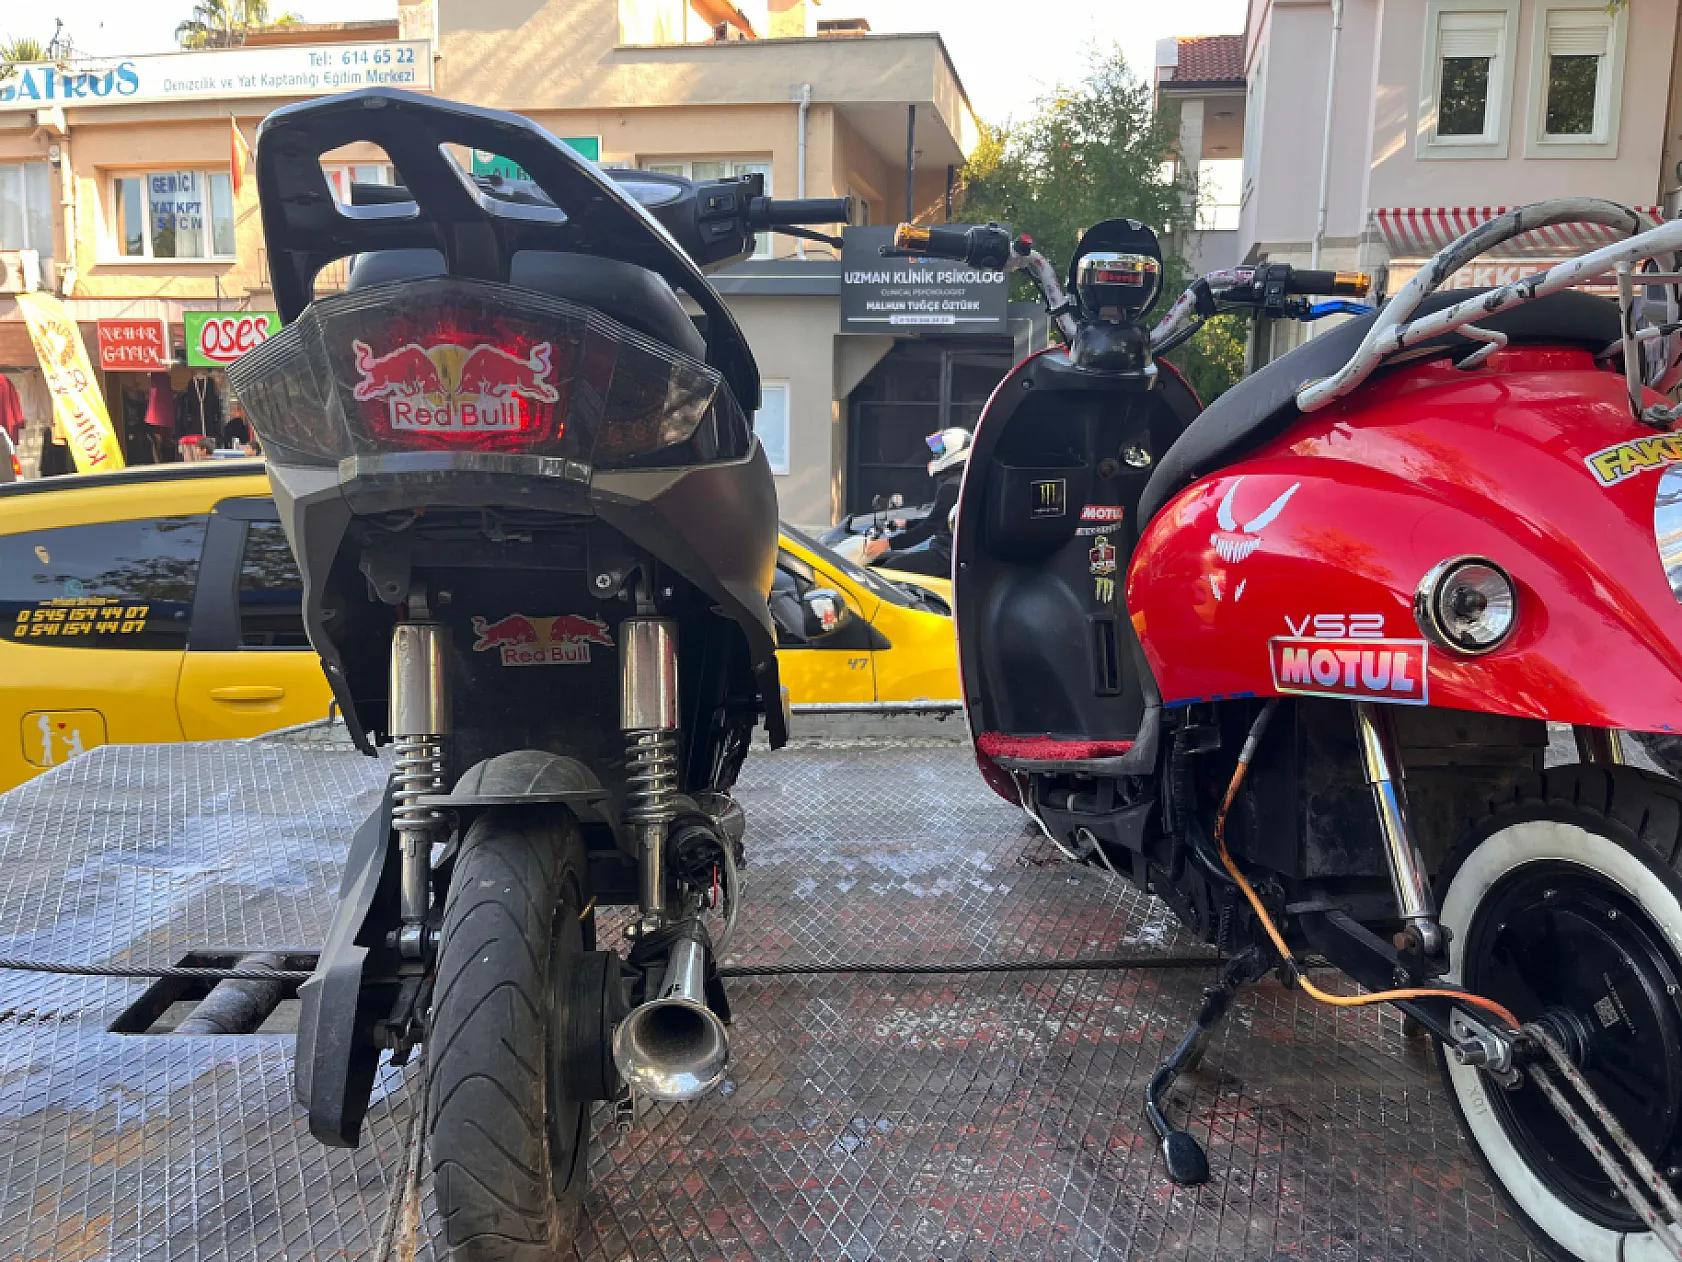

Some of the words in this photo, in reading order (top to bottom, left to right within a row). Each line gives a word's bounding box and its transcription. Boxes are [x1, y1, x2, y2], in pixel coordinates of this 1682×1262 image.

[342, 50, 369, 65] 614
[373, 49, 391, 64] 65
[396, 48, 415, 63] 22
[220, 78, 233, 88] ve
[238, 74, 257, 87] Yat
[323, 70, 362, 87] Eğitim
[366, 68, 415, 84] Merkezi
[844, 271, 890, 284] UZMAN
[893, 268, 934, 284] KLİNİK
[936, 268, 1005, 284] PSİKOLOG
[941, 299, 980, 311] ÖZTÜRK
[394, 401, 451, 426] Red
[461, 402, 515, 426] Bull
[16, 610, 31, 622] 0
[32, 608, 68, 622] 545
[101, 606, 124, 619] 44
[124, 605, 150, 619] 07
[14, 623, 29, 637] 0
[62, 621, 93, 636] 154
[95, 621, 119, 634] 44
[120, 620, 146, 633] 07
[1283, 613, 1385, 638] VS2
[503, 648, 546, 663] Red
[551, 645, 588, 661] Bull
[847, 657, 869, 670] 47
[1281, 646, 1414, 691] MOTUL
